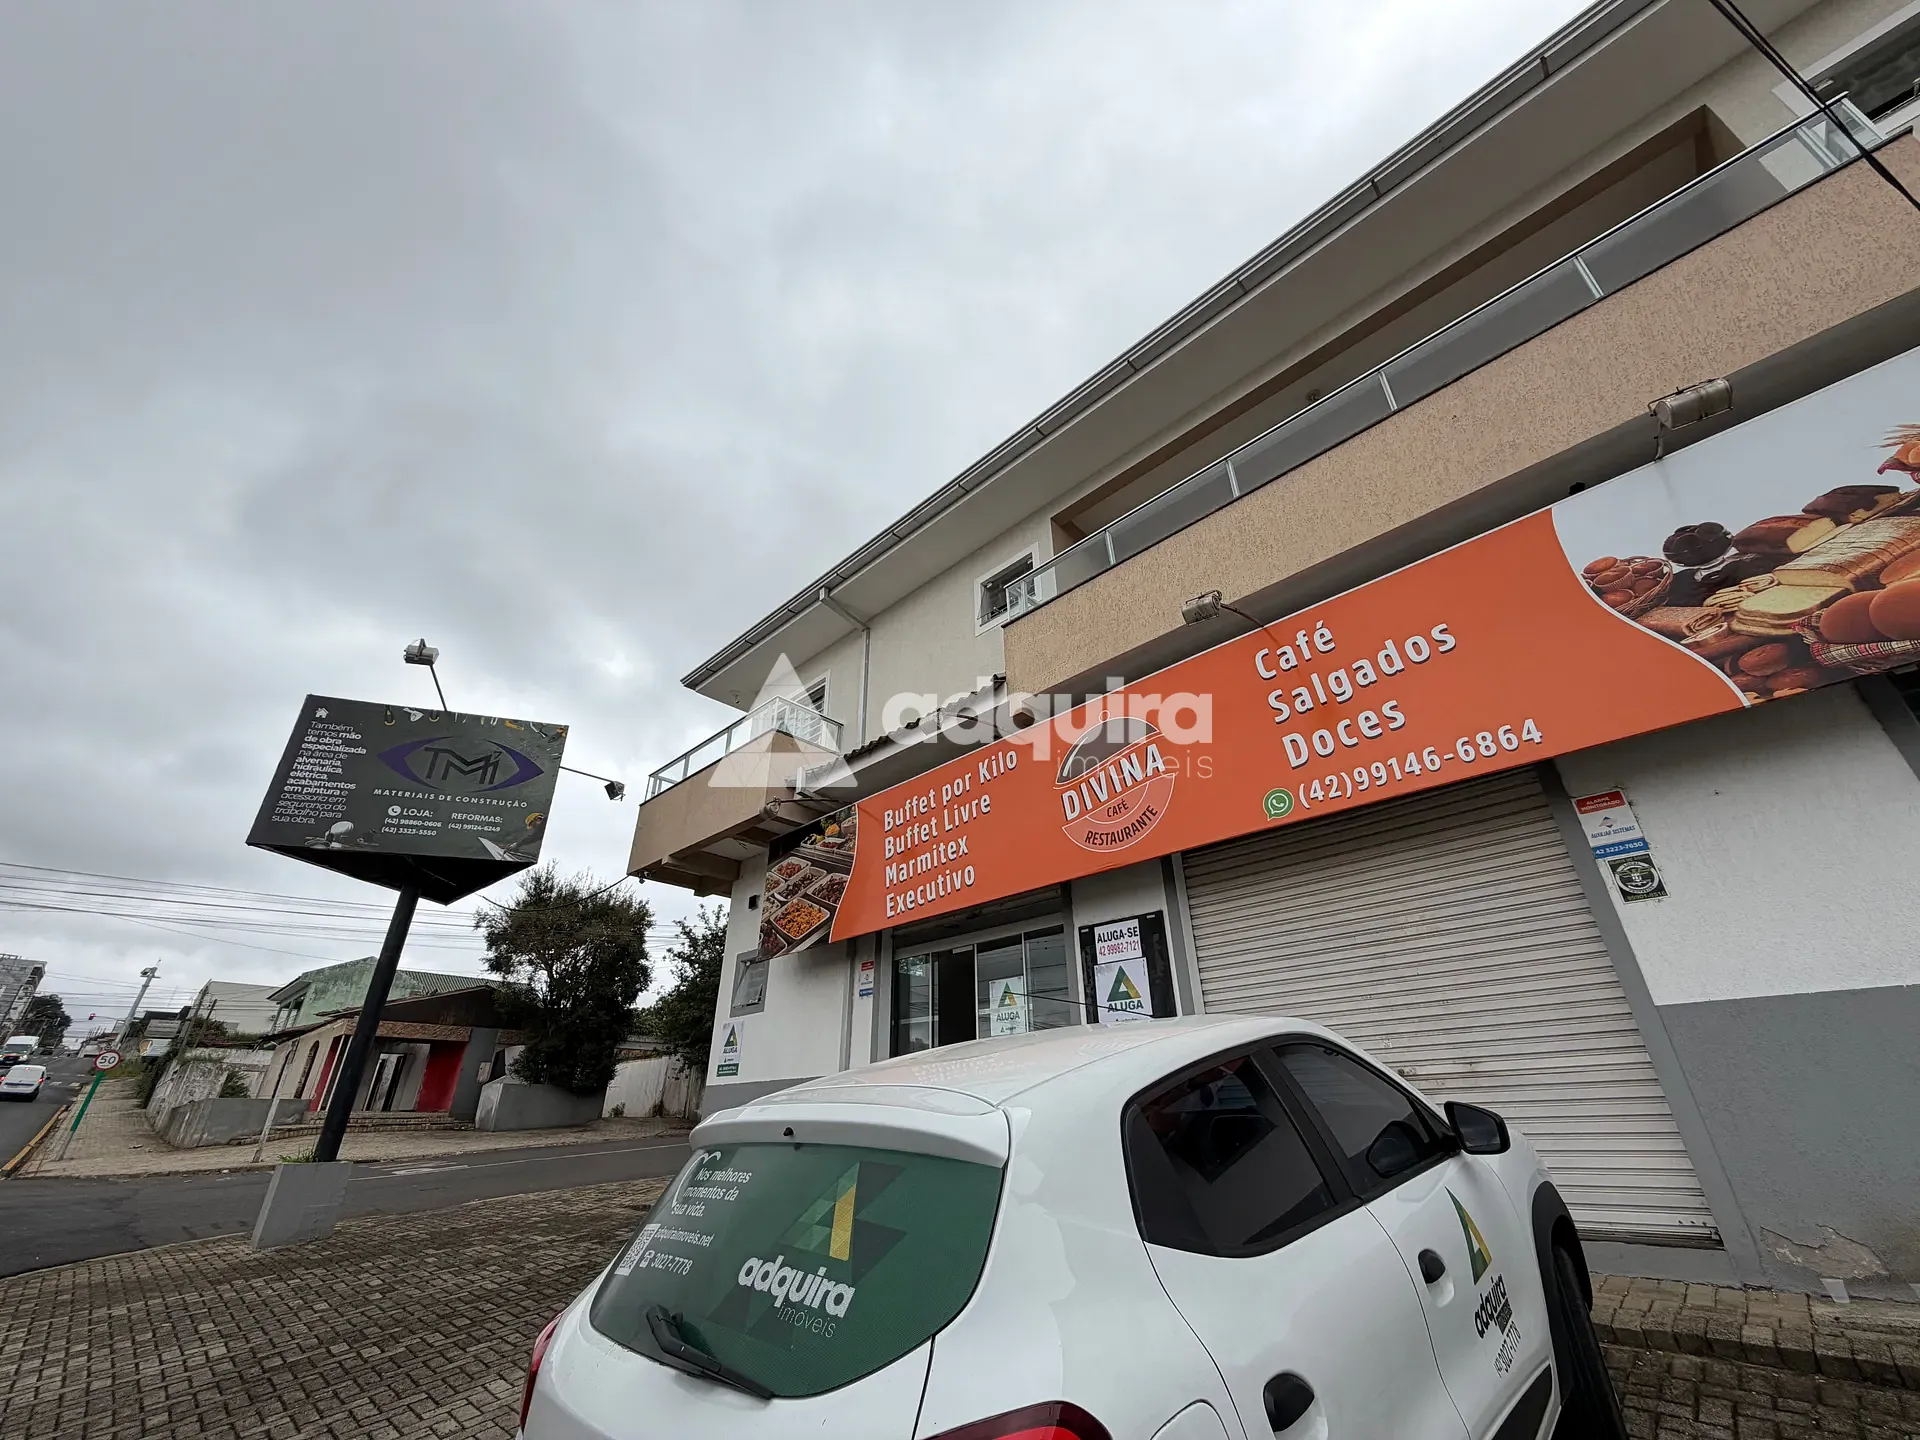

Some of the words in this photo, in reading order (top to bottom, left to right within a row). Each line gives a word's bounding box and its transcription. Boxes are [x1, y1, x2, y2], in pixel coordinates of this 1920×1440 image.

[1255, 620, 1336, 680] Café
[1267, 622, 1457, 724] Salgados
[307, 729, 338, 738] temos
[339, 731, 362, 740] mão
[311, 721, 354, 732] Também
[1282, 699, 1406, 769] Doces
[301, 743, 367, 754] especializada
[334, 752, 348, 760] de
[1298, 718, 1542, 810] (42)99146-6864
[287, 778, 357, 790] acabamentos
[1061, 743, 1166, 821] DIVINA
[302, 786, 340, 796] pintura
[373, 788, 435, 800] MATERIAIS
[438, 794, 451, 802] DE
[455, 795, 528, 808] CONSTRUÇÃO
[884, 795, 937, 832] Buffet
[942, 770, 972, 805] por
[978, 749, 1018, 785] Kilo
[275, 807, 319, 816] trabalho
[319, 811, 342, 819] para
[277, 800, 332, 811] segurança
[332, 803, 347, 811] do
[403, 808, 434, 818] LOJA:
[1106, 798, 1129, 818] CAFÉ
[384, 817, 399, 825] (42)
[448, 822, 462, 830] (42)
[451, 813, 503, 823] REFORMAS:
[1084, 805, 1158, 846] RESTAURANTE
[381, 826, 397, 834] (42)
[884, 824, 939, 860] Buffet
[943, 794, 992, 832] Livre
[885, 834, 970, 888] Marmitex
[885, 865, 976, 919] Executivo
[1097, 926, 1139, 944] ALUGA-SE
[1107, 1000, 1144, 1013] ALUGA
[996, 1011, 1020, 1022] ALUGA
[99, 1055, 116, 1065] 50
[710, 1168, 752, 1183] melhores
[683, 1185, 726, 1201] momentos
[724, 1186, 739, 1201] da
[651, 1253, 693, 1275] 3027-7778
[738, 1254, 856, 1319] adquira
[1474, 1273, 1507, 1339] adquira
[777, 1302, 836, 1338] imóveis
